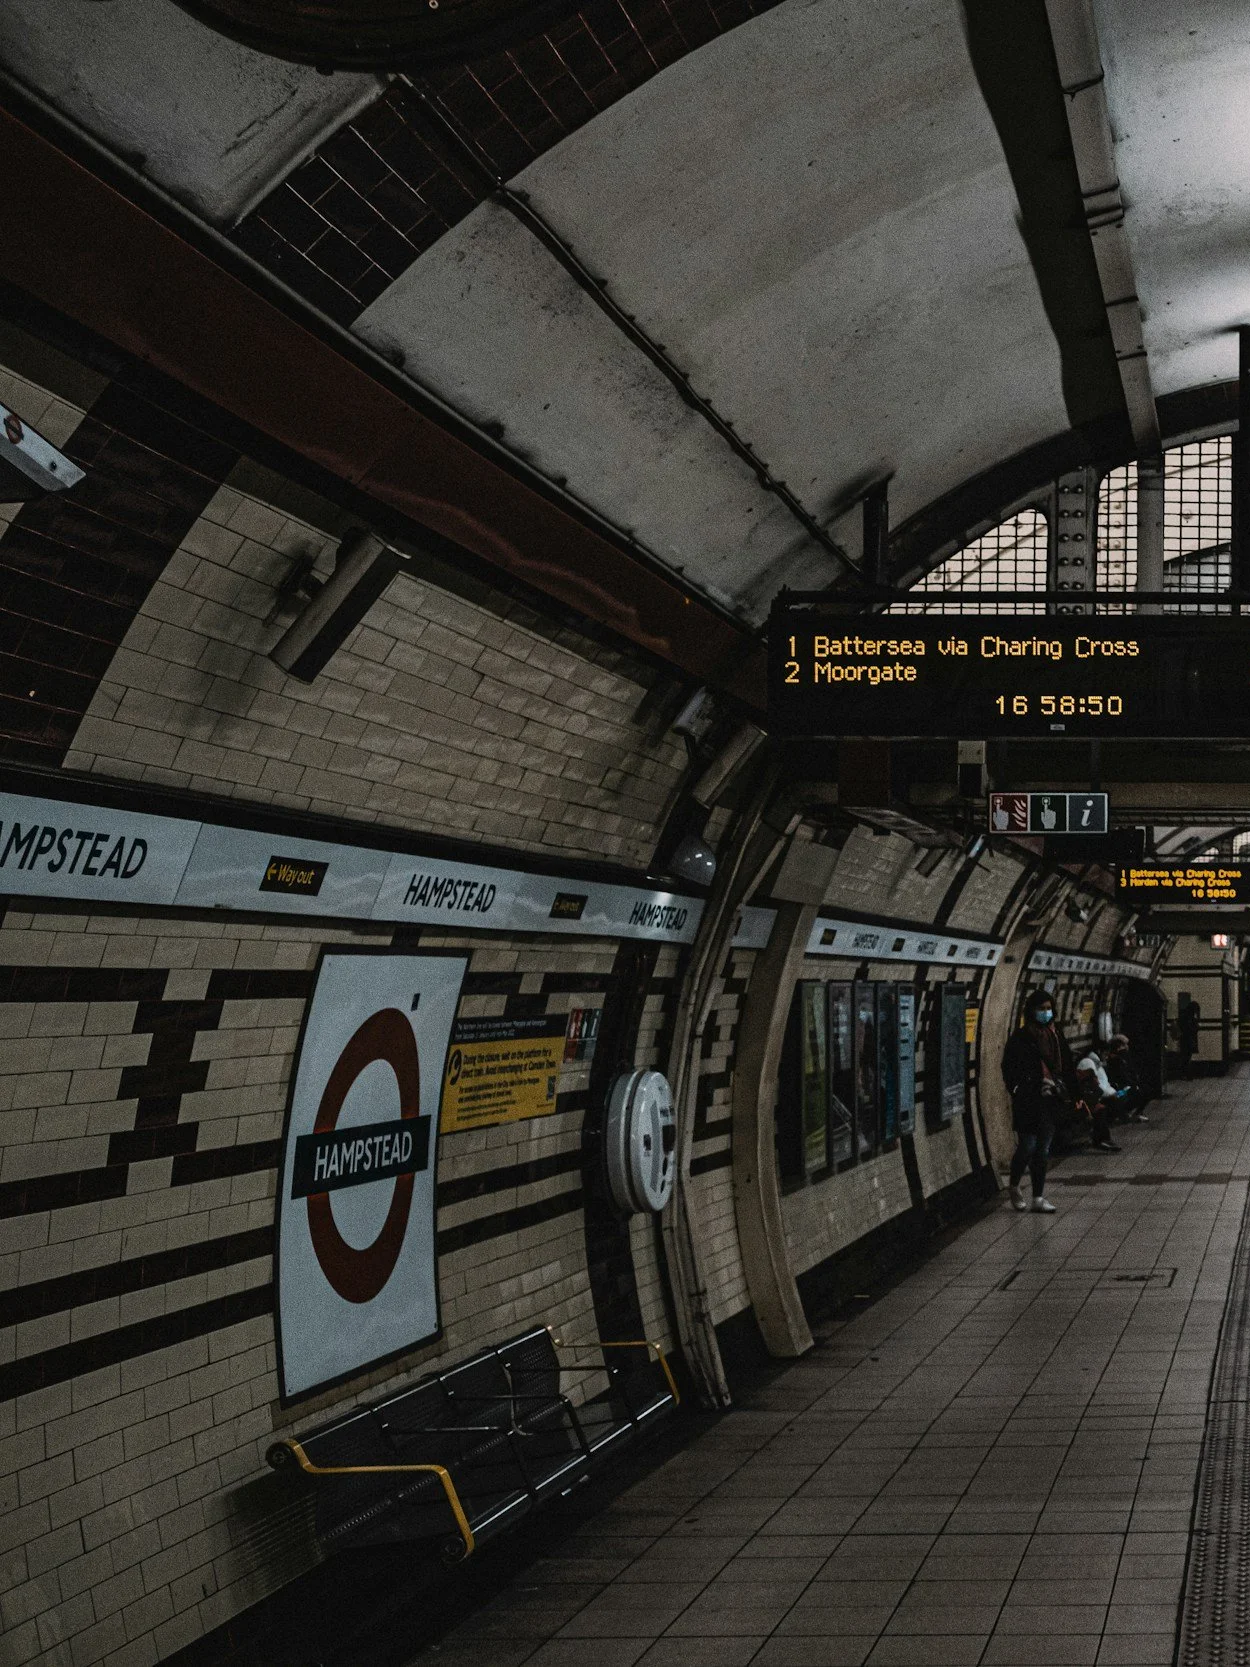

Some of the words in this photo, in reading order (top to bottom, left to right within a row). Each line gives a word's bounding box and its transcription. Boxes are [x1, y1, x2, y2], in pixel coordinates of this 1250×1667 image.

[788, 635, 797, 657] 1
[813, 635, 926, 658] Battersea
[937, 636, 969, 656] via
[980, 635, 1063, 661] Charing
[1075, 636, 1140, 659] Cross
[784, 661, 801, 684] 2
[813, 661, 918, 686] Moorgate
[995, 694, 1030, 716] 16
[1039, 694, 1124, 716] 58:50
[0, 820, 148, 879] MPSTEAD
[278, 863, 299, 887] Way
[296, 868, 316, 886] out
[403, 873, 497, 913] HAMPSTEAD
[628, 901, 689, 931] HAMPSTEAD
[313, 1131, 413, 1182] HAMPSTEAD
